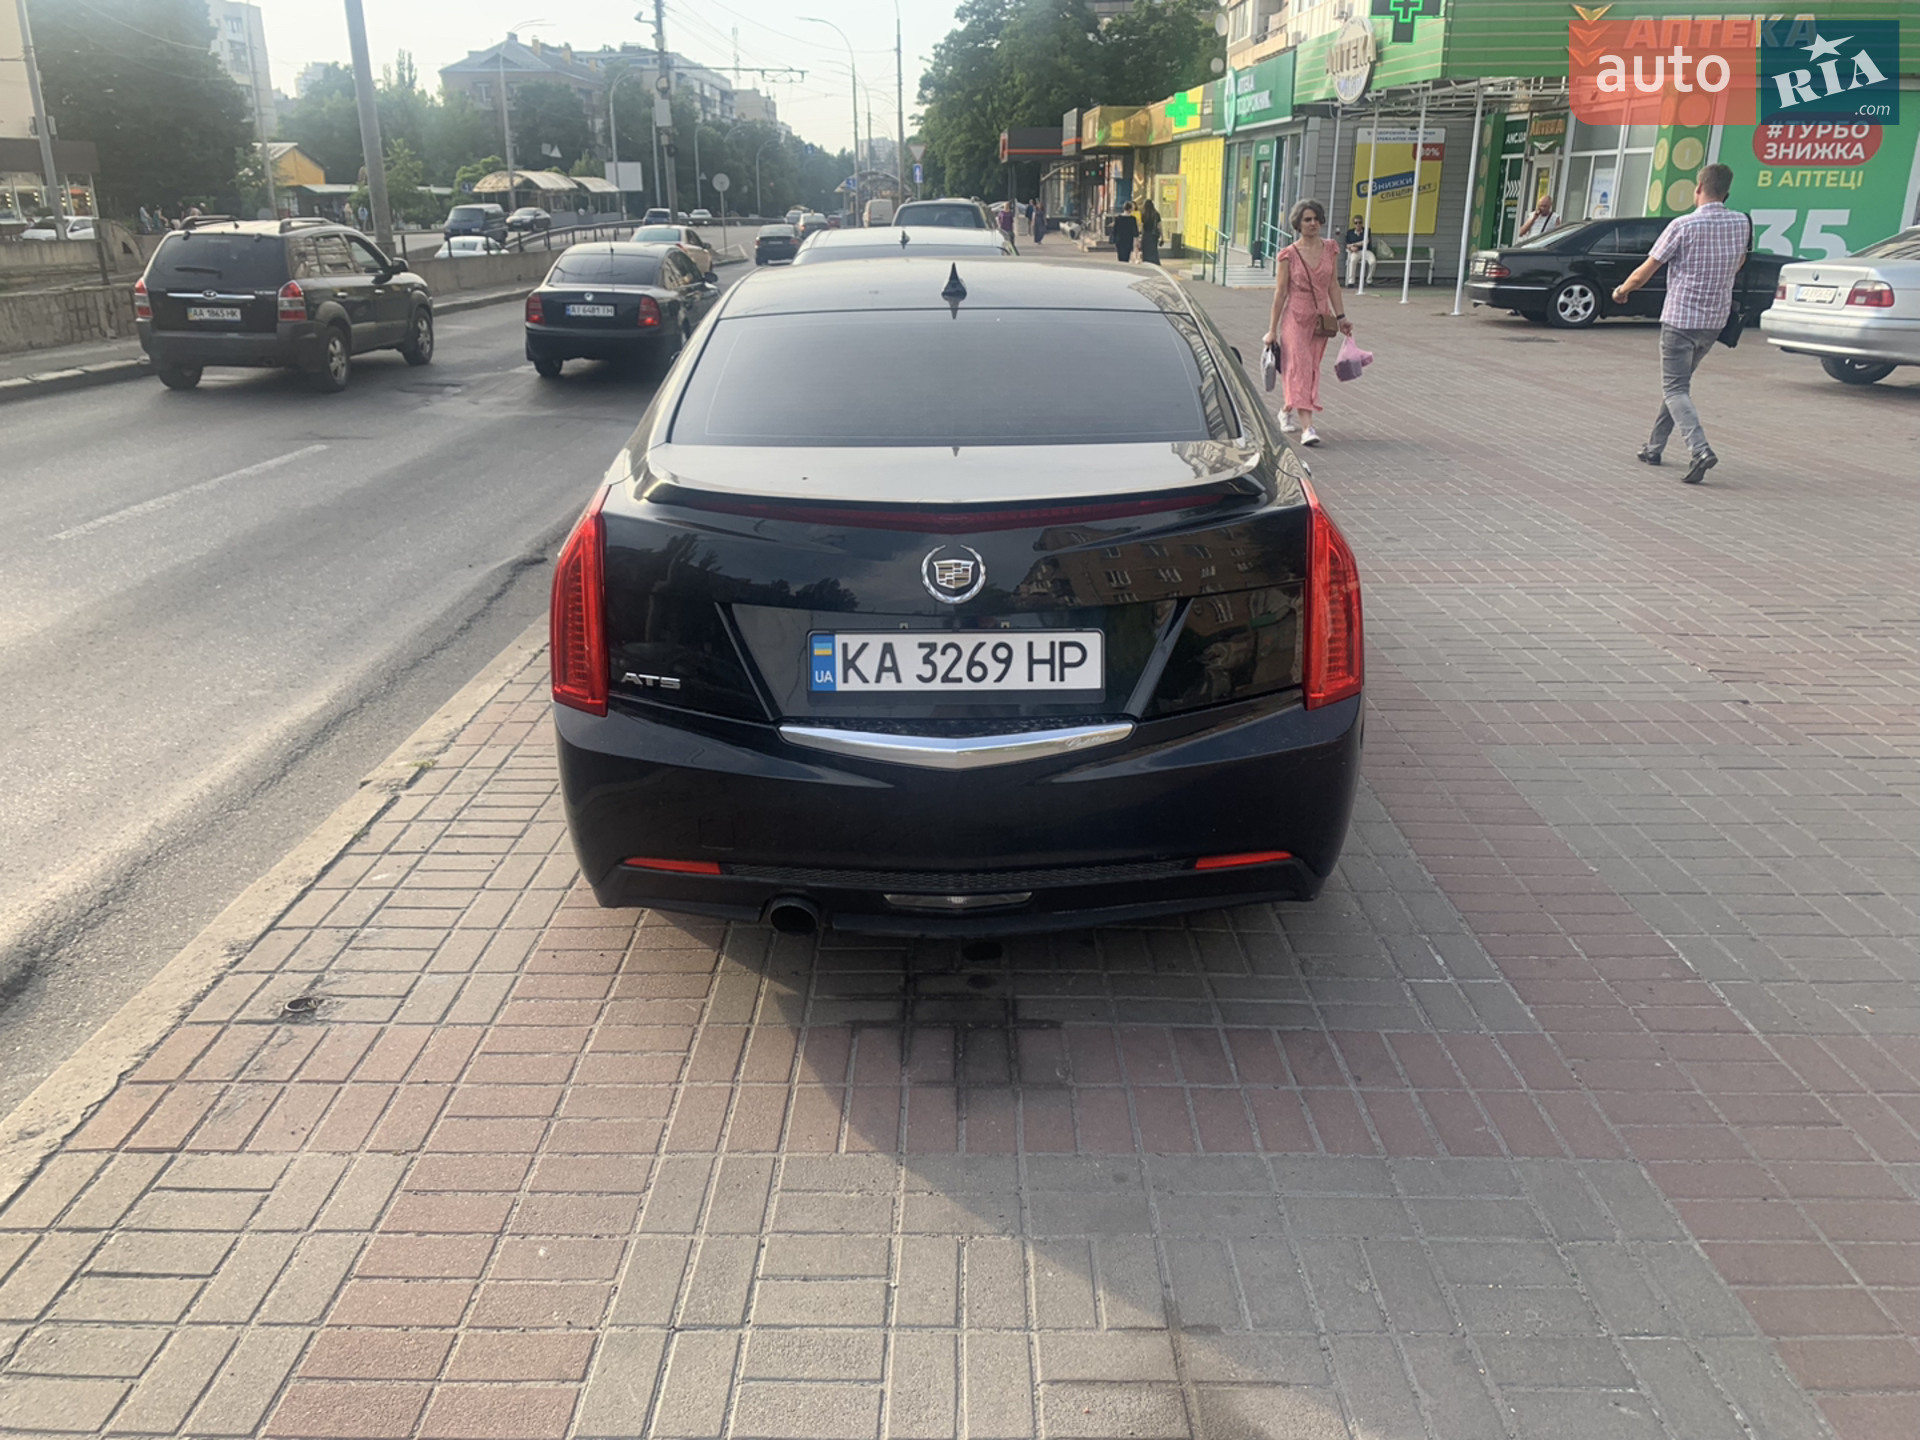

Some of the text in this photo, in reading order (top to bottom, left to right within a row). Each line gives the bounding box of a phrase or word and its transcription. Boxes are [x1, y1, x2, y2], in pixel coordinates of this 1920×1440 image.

[1623, 13, 1818, 49] АПТЕКА
[1766, 120, 1870, 139] #ТУРБО
[1763, 142, 1866, 160] ЗНИЖКА
[1757, 170, 1864, 190] В АПТЕЦІ
[193, 308, 205, 318] AA
[841, 641, 1088, 684] KA 3269 HP
[621, 672, 681, 689] ATS
[815, 670, 833, 683] UA
